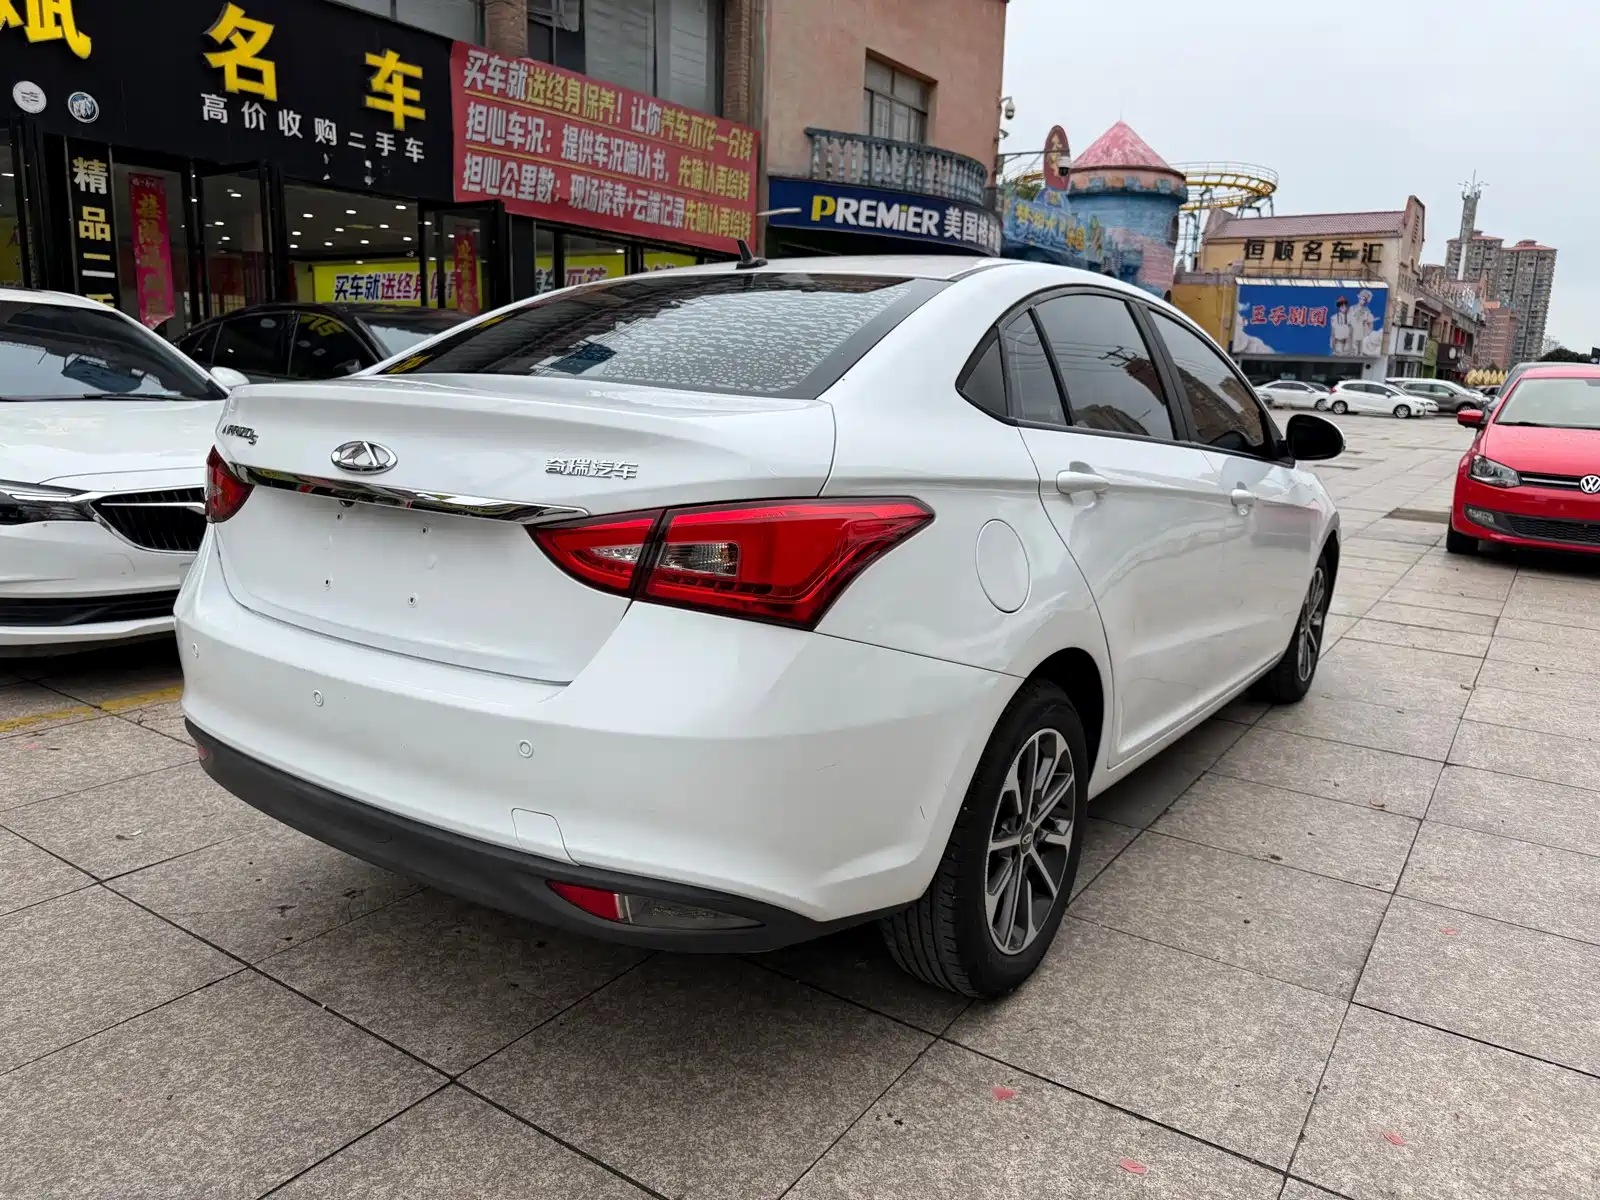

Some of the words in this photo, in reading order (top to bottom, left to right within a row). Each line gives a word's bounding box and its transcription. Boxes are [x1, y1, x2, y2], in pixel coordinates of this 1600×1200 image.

[200, 92, 425, 163] 高价收购二手车
[1244, 238, 1384, 263] 恒顺名车汇
[544, 457, 639, 480] 奇瑞汽车
